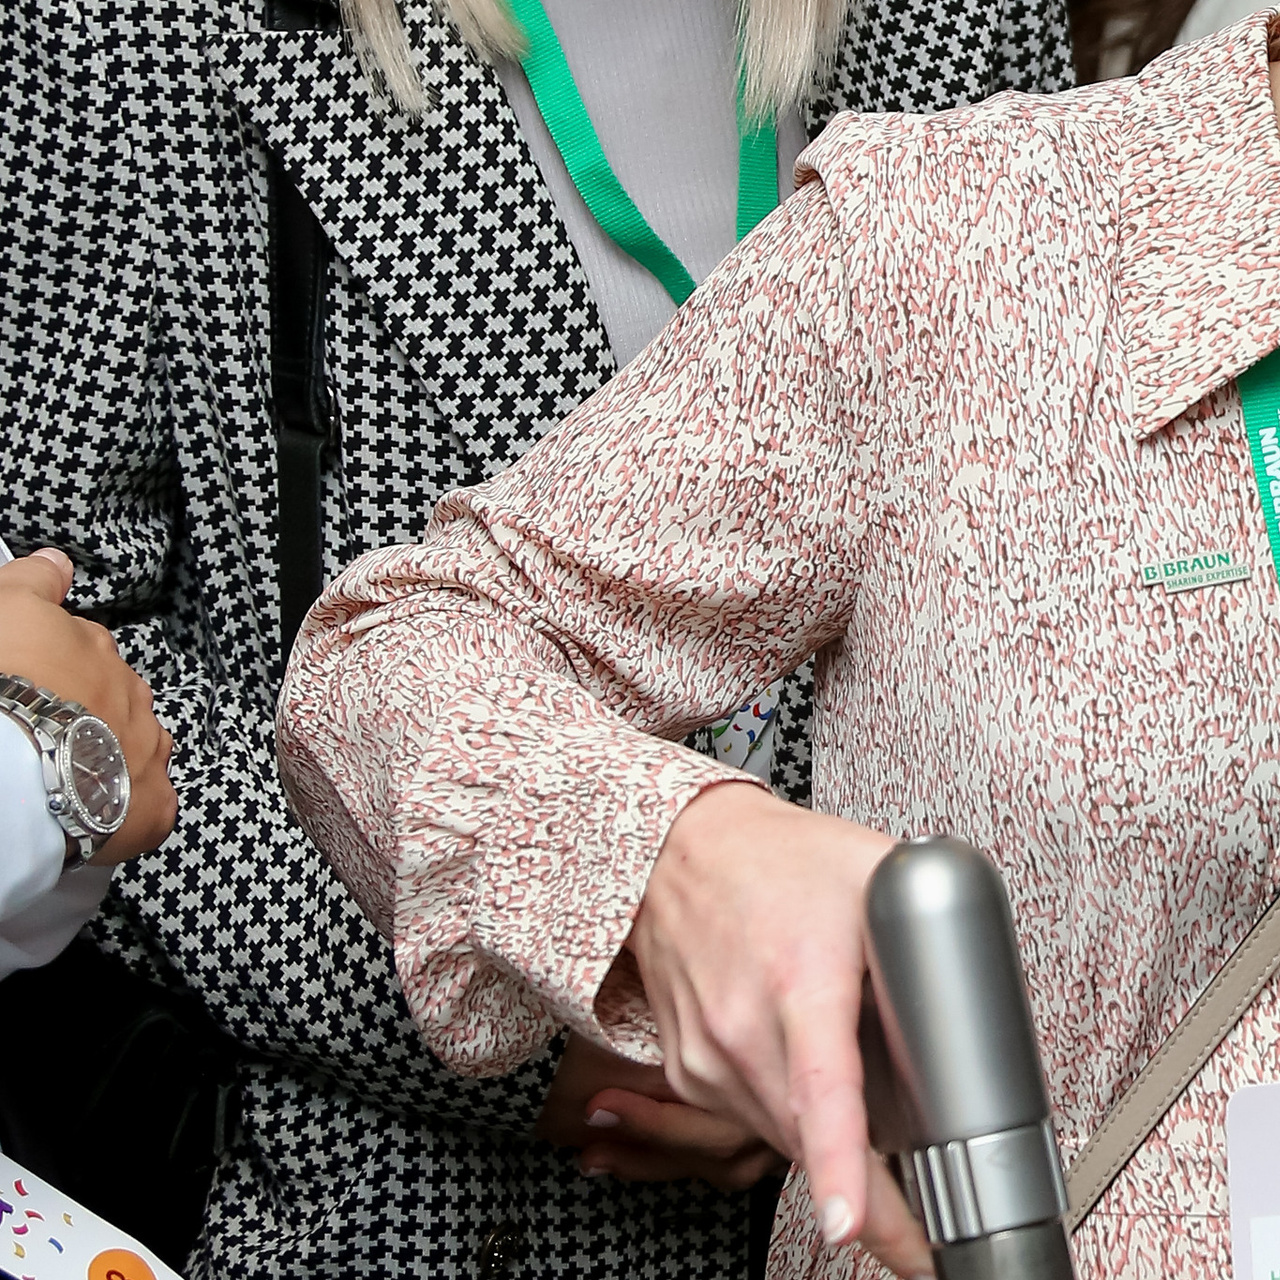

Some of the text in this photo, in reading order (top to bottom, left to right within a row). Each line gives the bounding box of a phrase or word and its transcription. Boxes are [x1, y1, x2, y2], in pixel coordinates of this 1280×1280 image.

[1163, 552, 1231, 577] BRAUN
[1166, 566, 1248, 589] SHARING EXPERTISE
